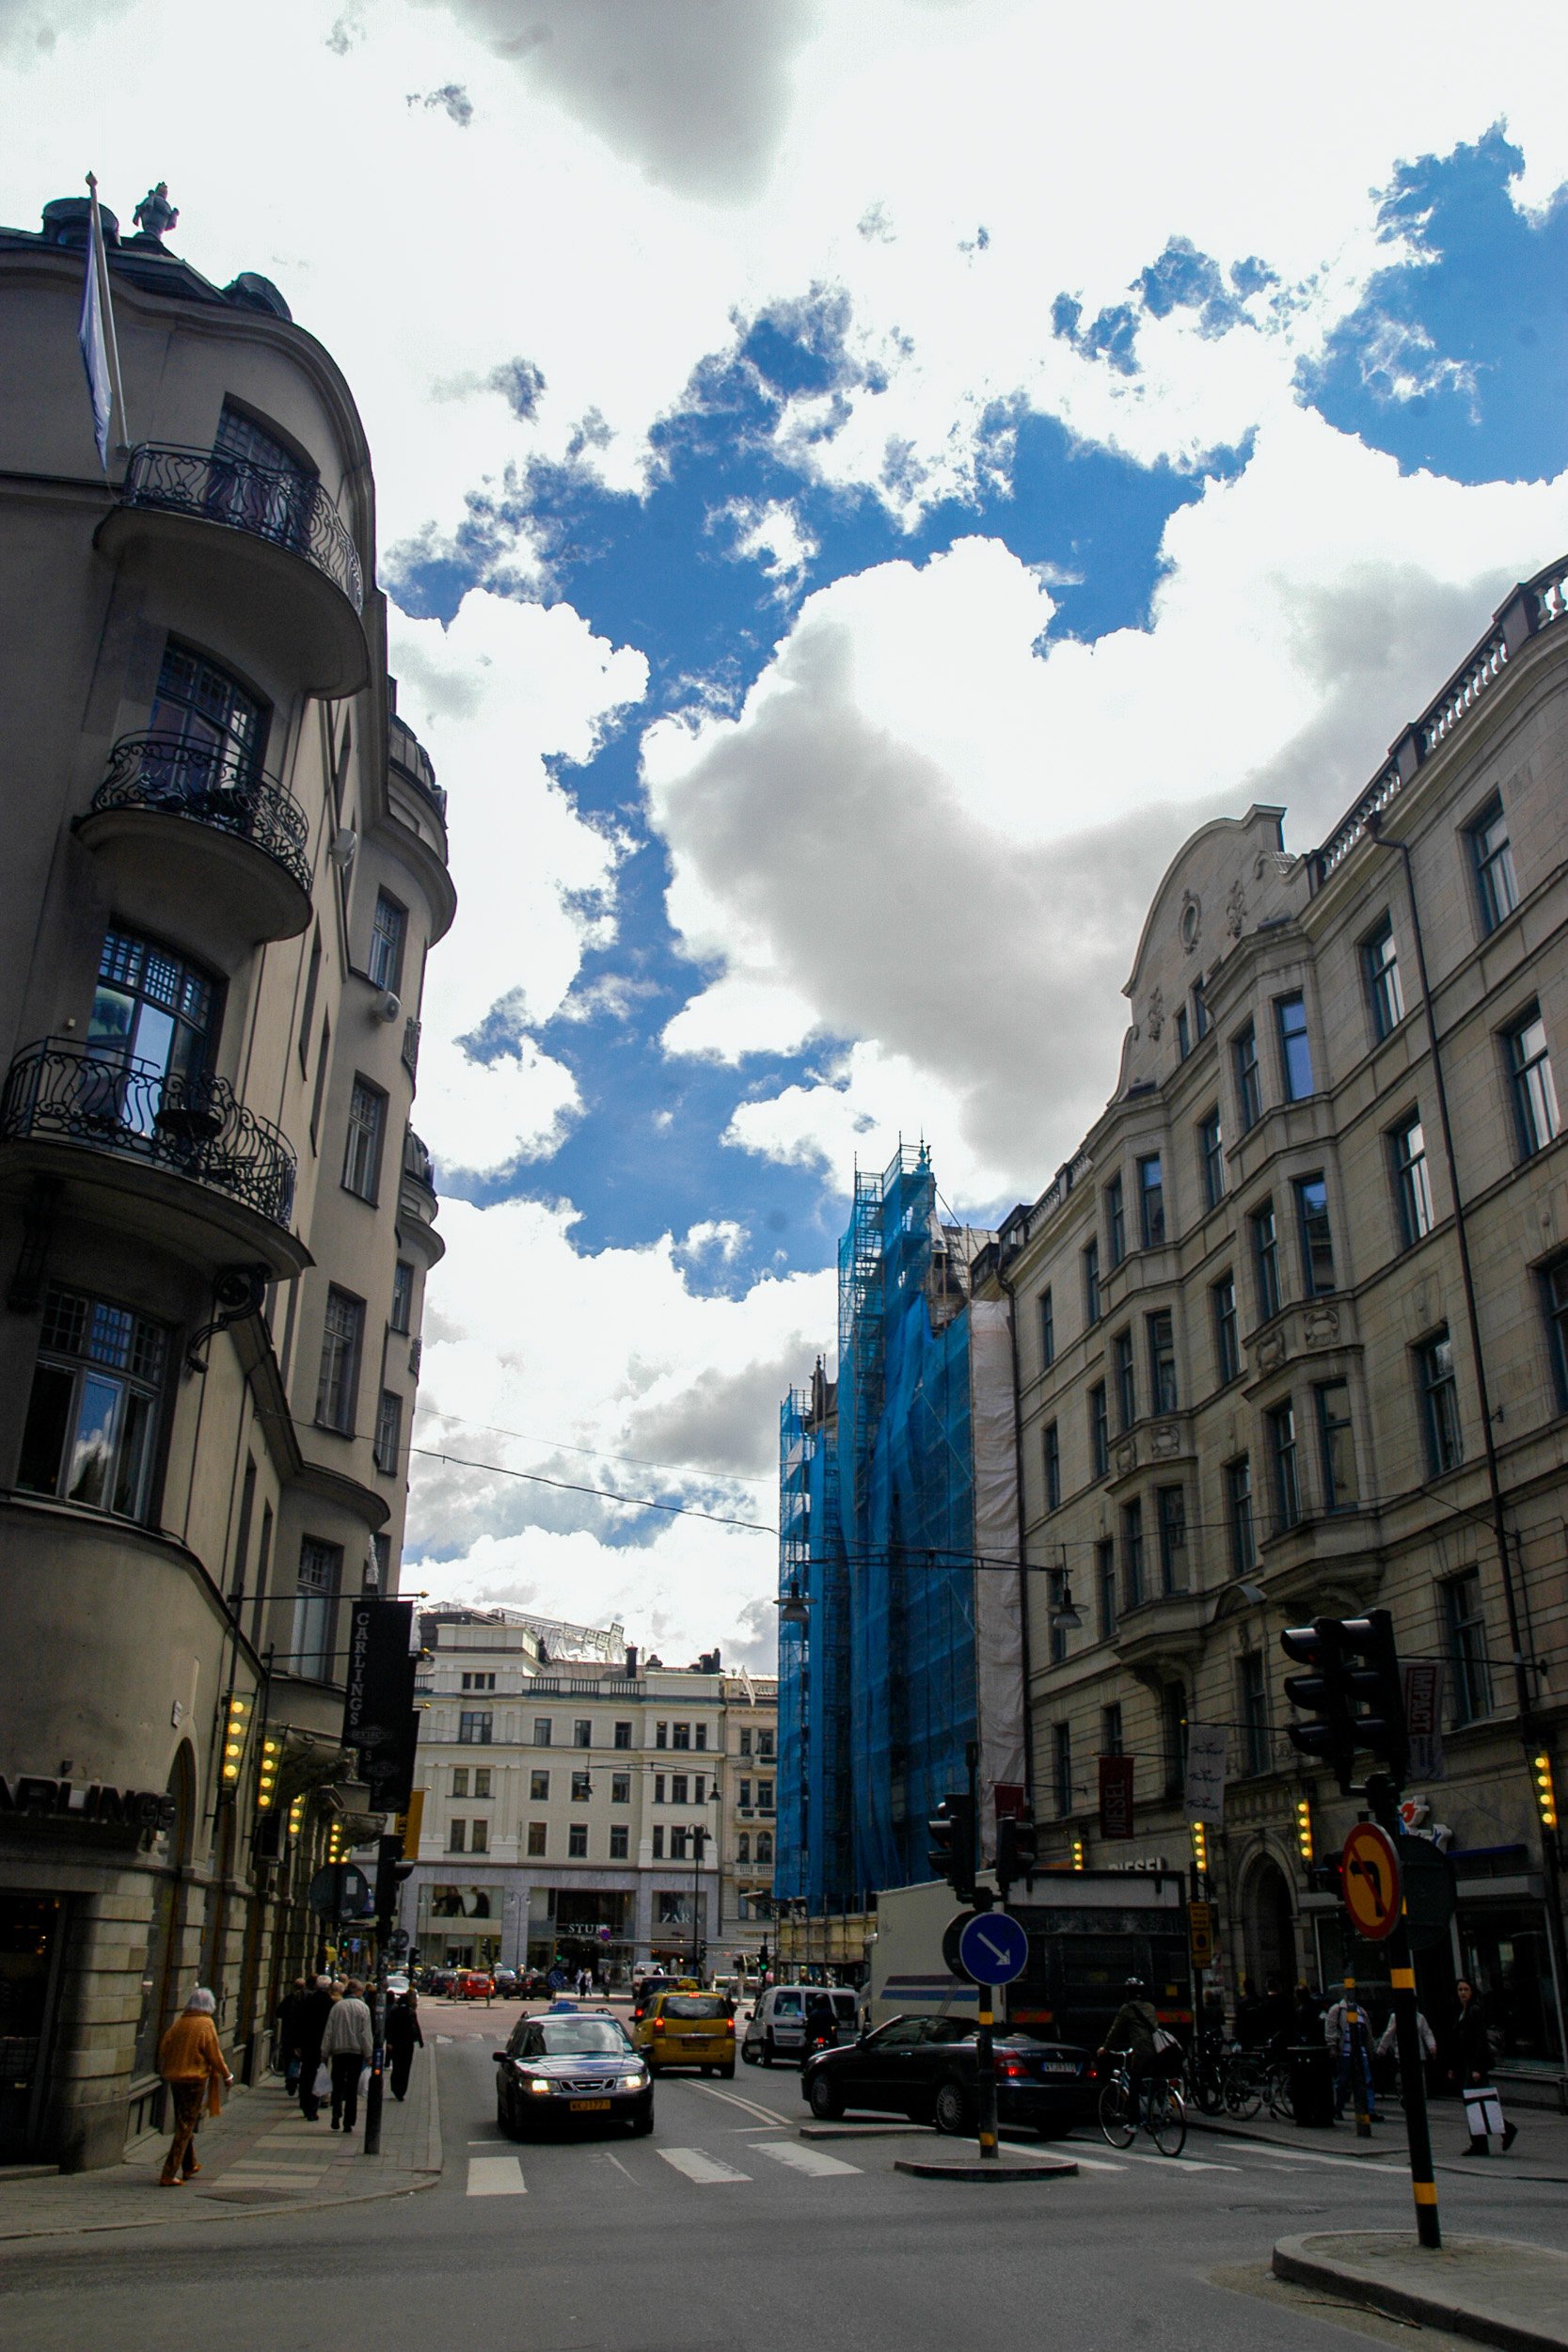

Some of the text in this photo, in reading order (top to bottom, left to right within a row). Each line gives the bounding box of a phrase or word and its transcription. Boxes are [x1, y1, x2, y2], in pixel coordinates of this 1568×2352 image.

[350, 1613, 370, 1725] CARLINGS
[1105, 1778, 1127, 1836] DIESEL
[568, 1924, 611, 1934] STUR
